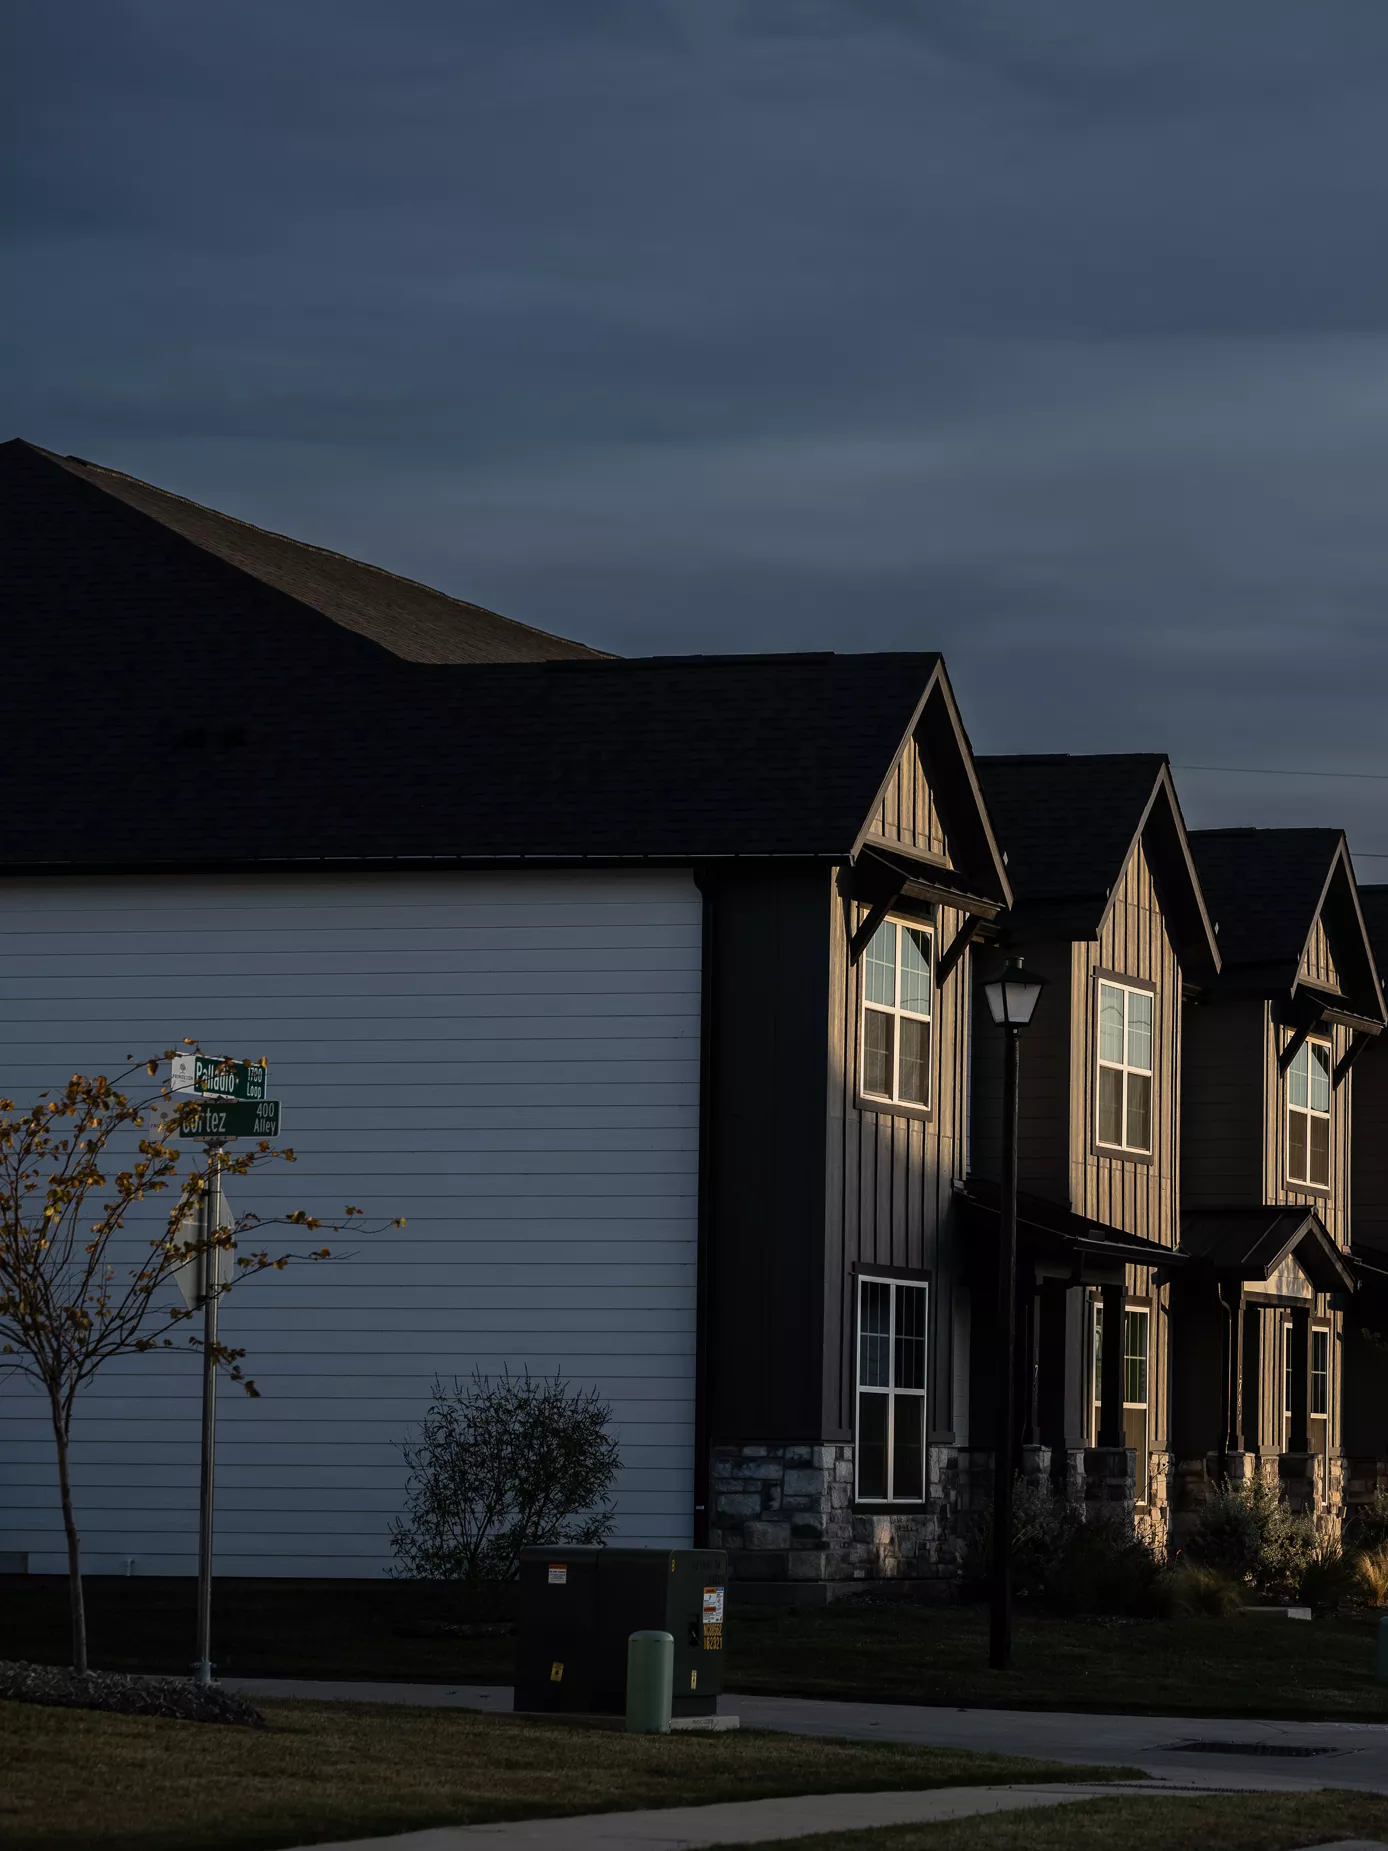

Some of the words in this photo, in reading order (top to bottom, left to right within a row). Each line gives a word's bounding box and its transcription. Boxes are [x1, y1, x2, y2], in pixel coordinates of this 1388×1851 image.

[195, 1061, 235, 1092] Palladio
[246, 1082, 262, 1099] Loop
[256, 1103, 275, 1117] 400
[253, 1118, 276, 1136] Alley
